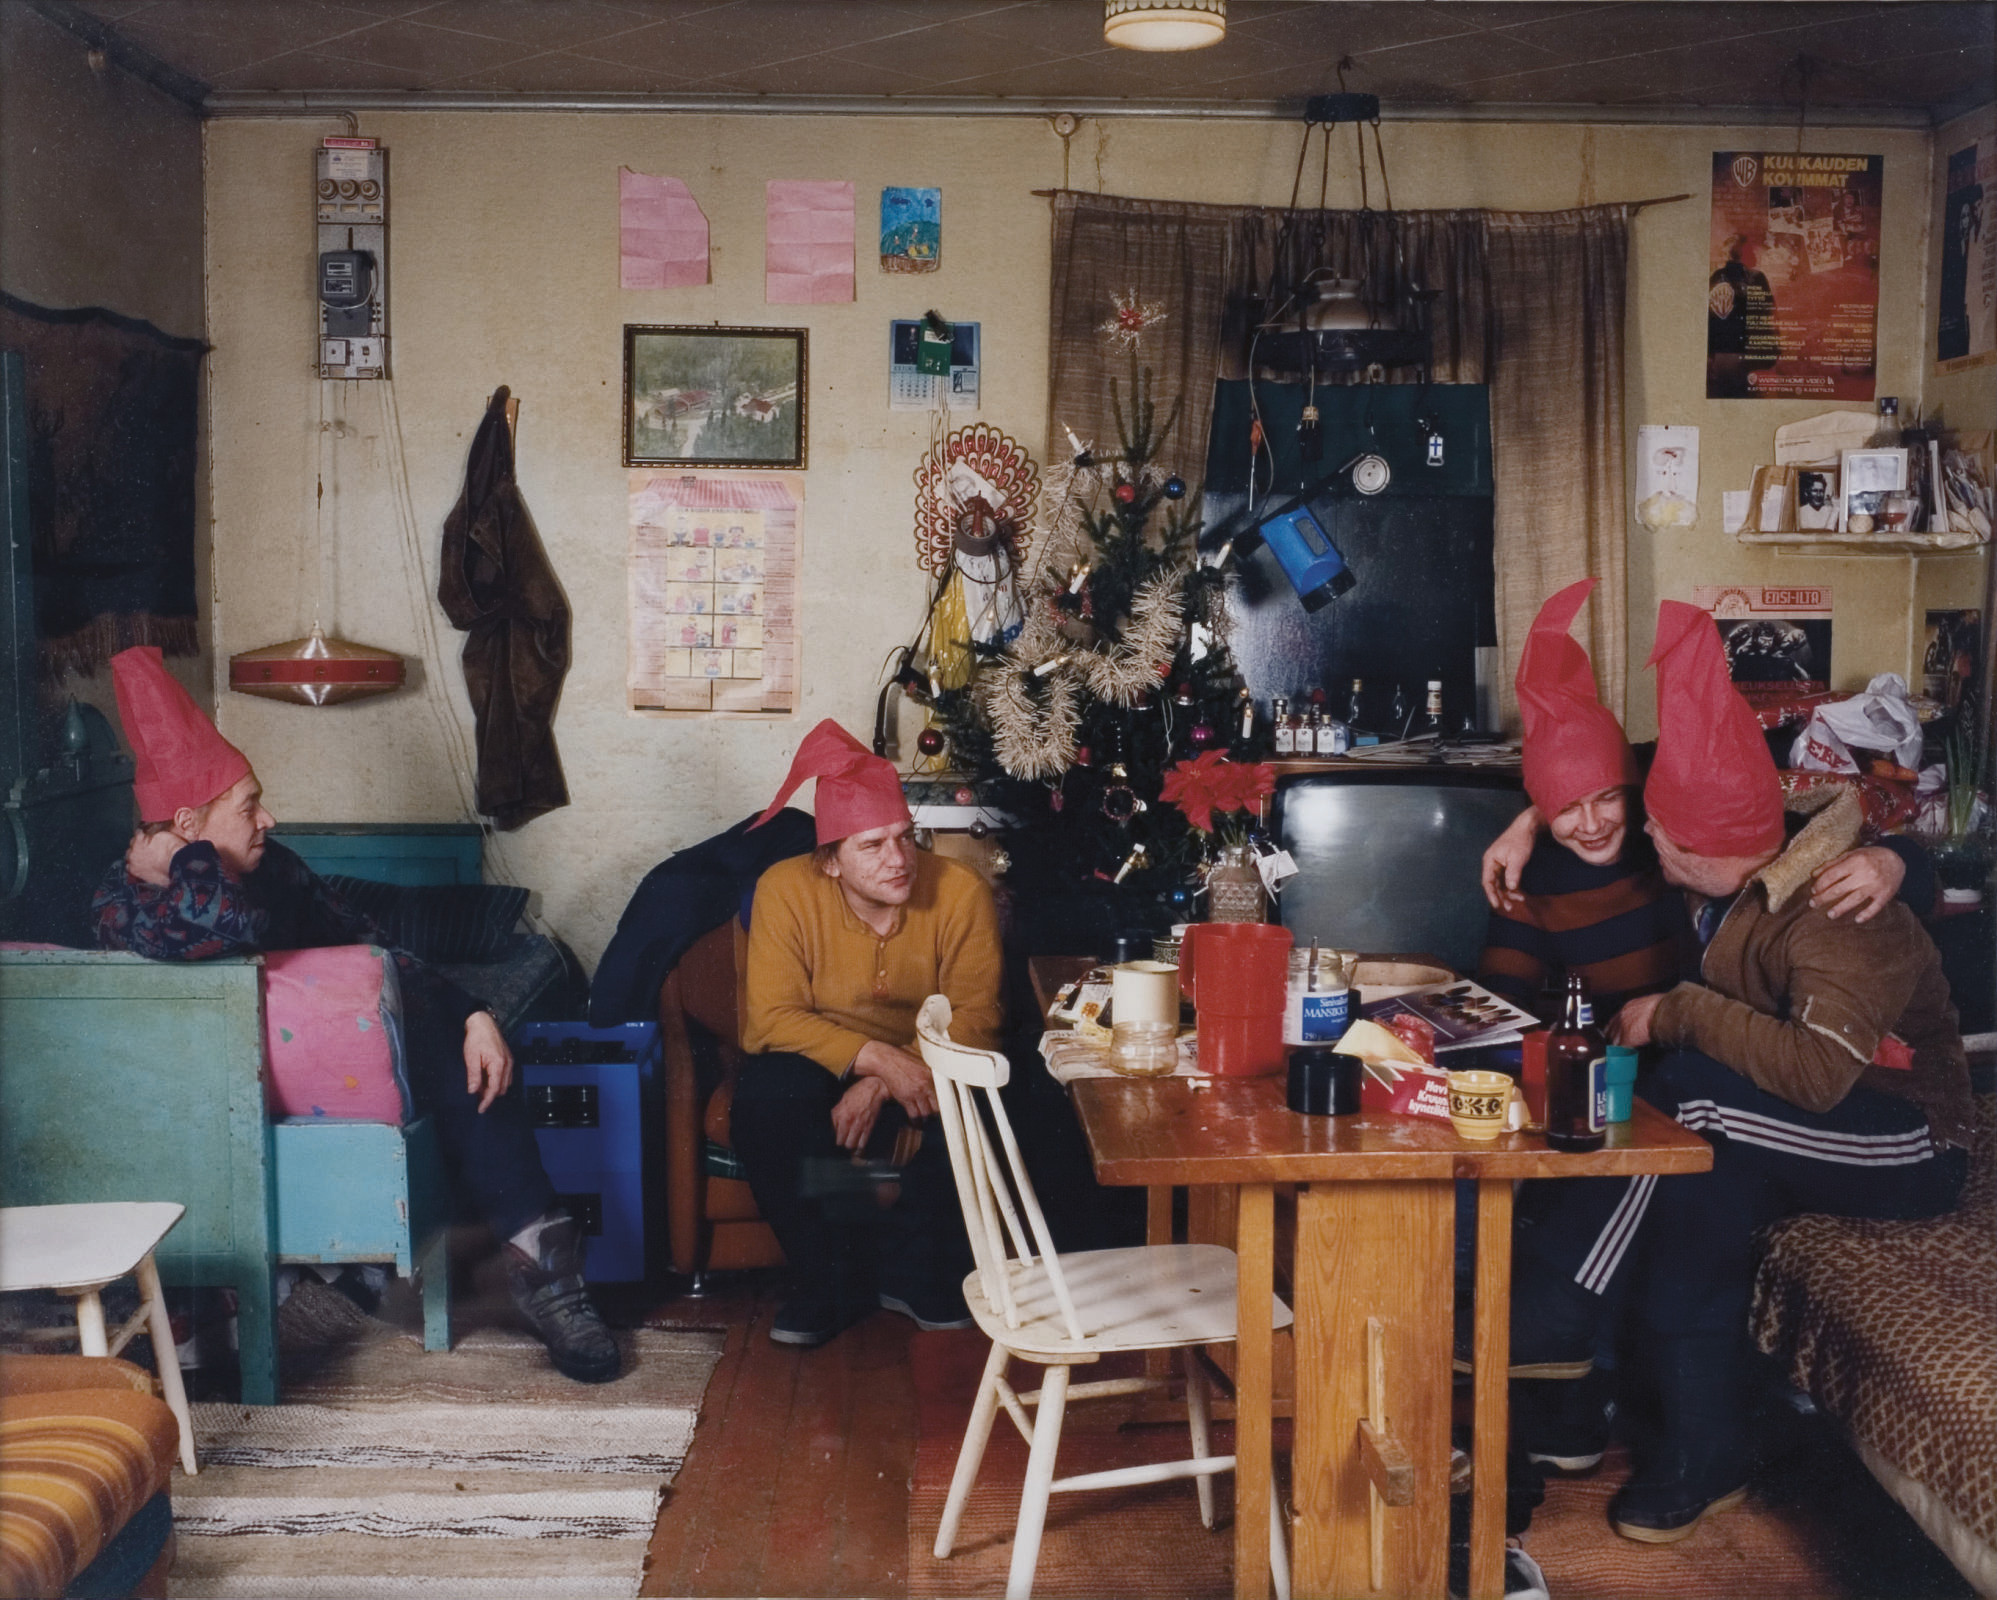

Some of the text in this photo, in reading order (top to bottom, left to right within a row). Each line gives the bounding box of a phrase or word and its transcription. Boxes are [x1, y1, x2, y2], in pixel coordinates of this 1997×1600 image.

[1763, 156, 1868, 171] KUUKAUDEN
[1763, 173, 1849, 187] KOVIMMAT
[1424, 1080, 1448, 1095] Havi
